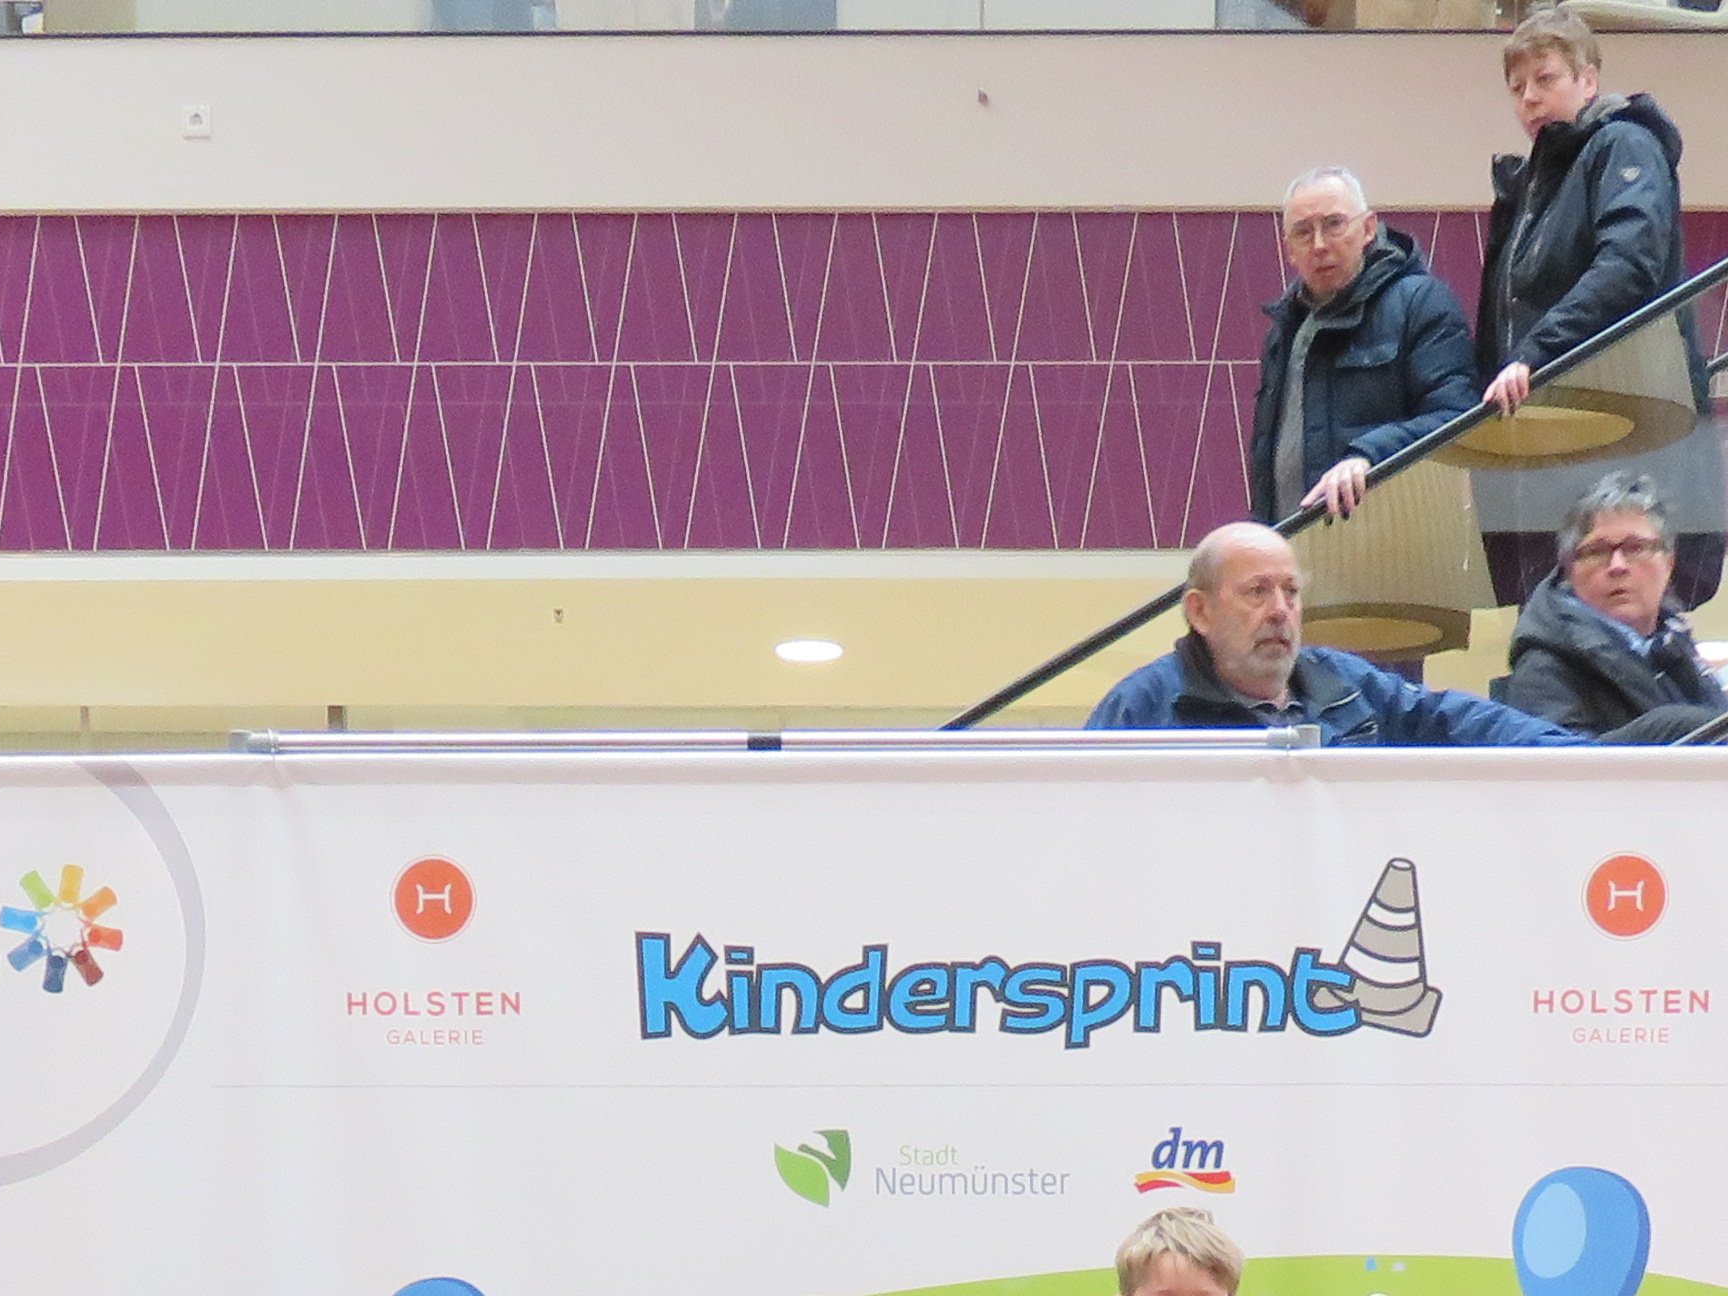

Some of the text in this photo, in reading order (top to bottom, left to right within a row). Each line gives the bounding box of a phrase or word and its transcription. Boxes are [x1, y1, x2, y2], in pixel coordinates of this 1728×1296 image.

[635, 931, 1360, 1048] Kindersprint
[1532, 988, 1713, 1015] HOLSTEN
[346, 991, 522, 1018] HOLSTEN
[385, 1028, 485, 1046] GALERIE
[1571, 1026, 1671, 1045] GALERIE
[897, 1143, 960, 1167] Stadt
[1151, 1124, 1224, 1172] dm
[874, 1161, 1070, 1197] Neumünster
